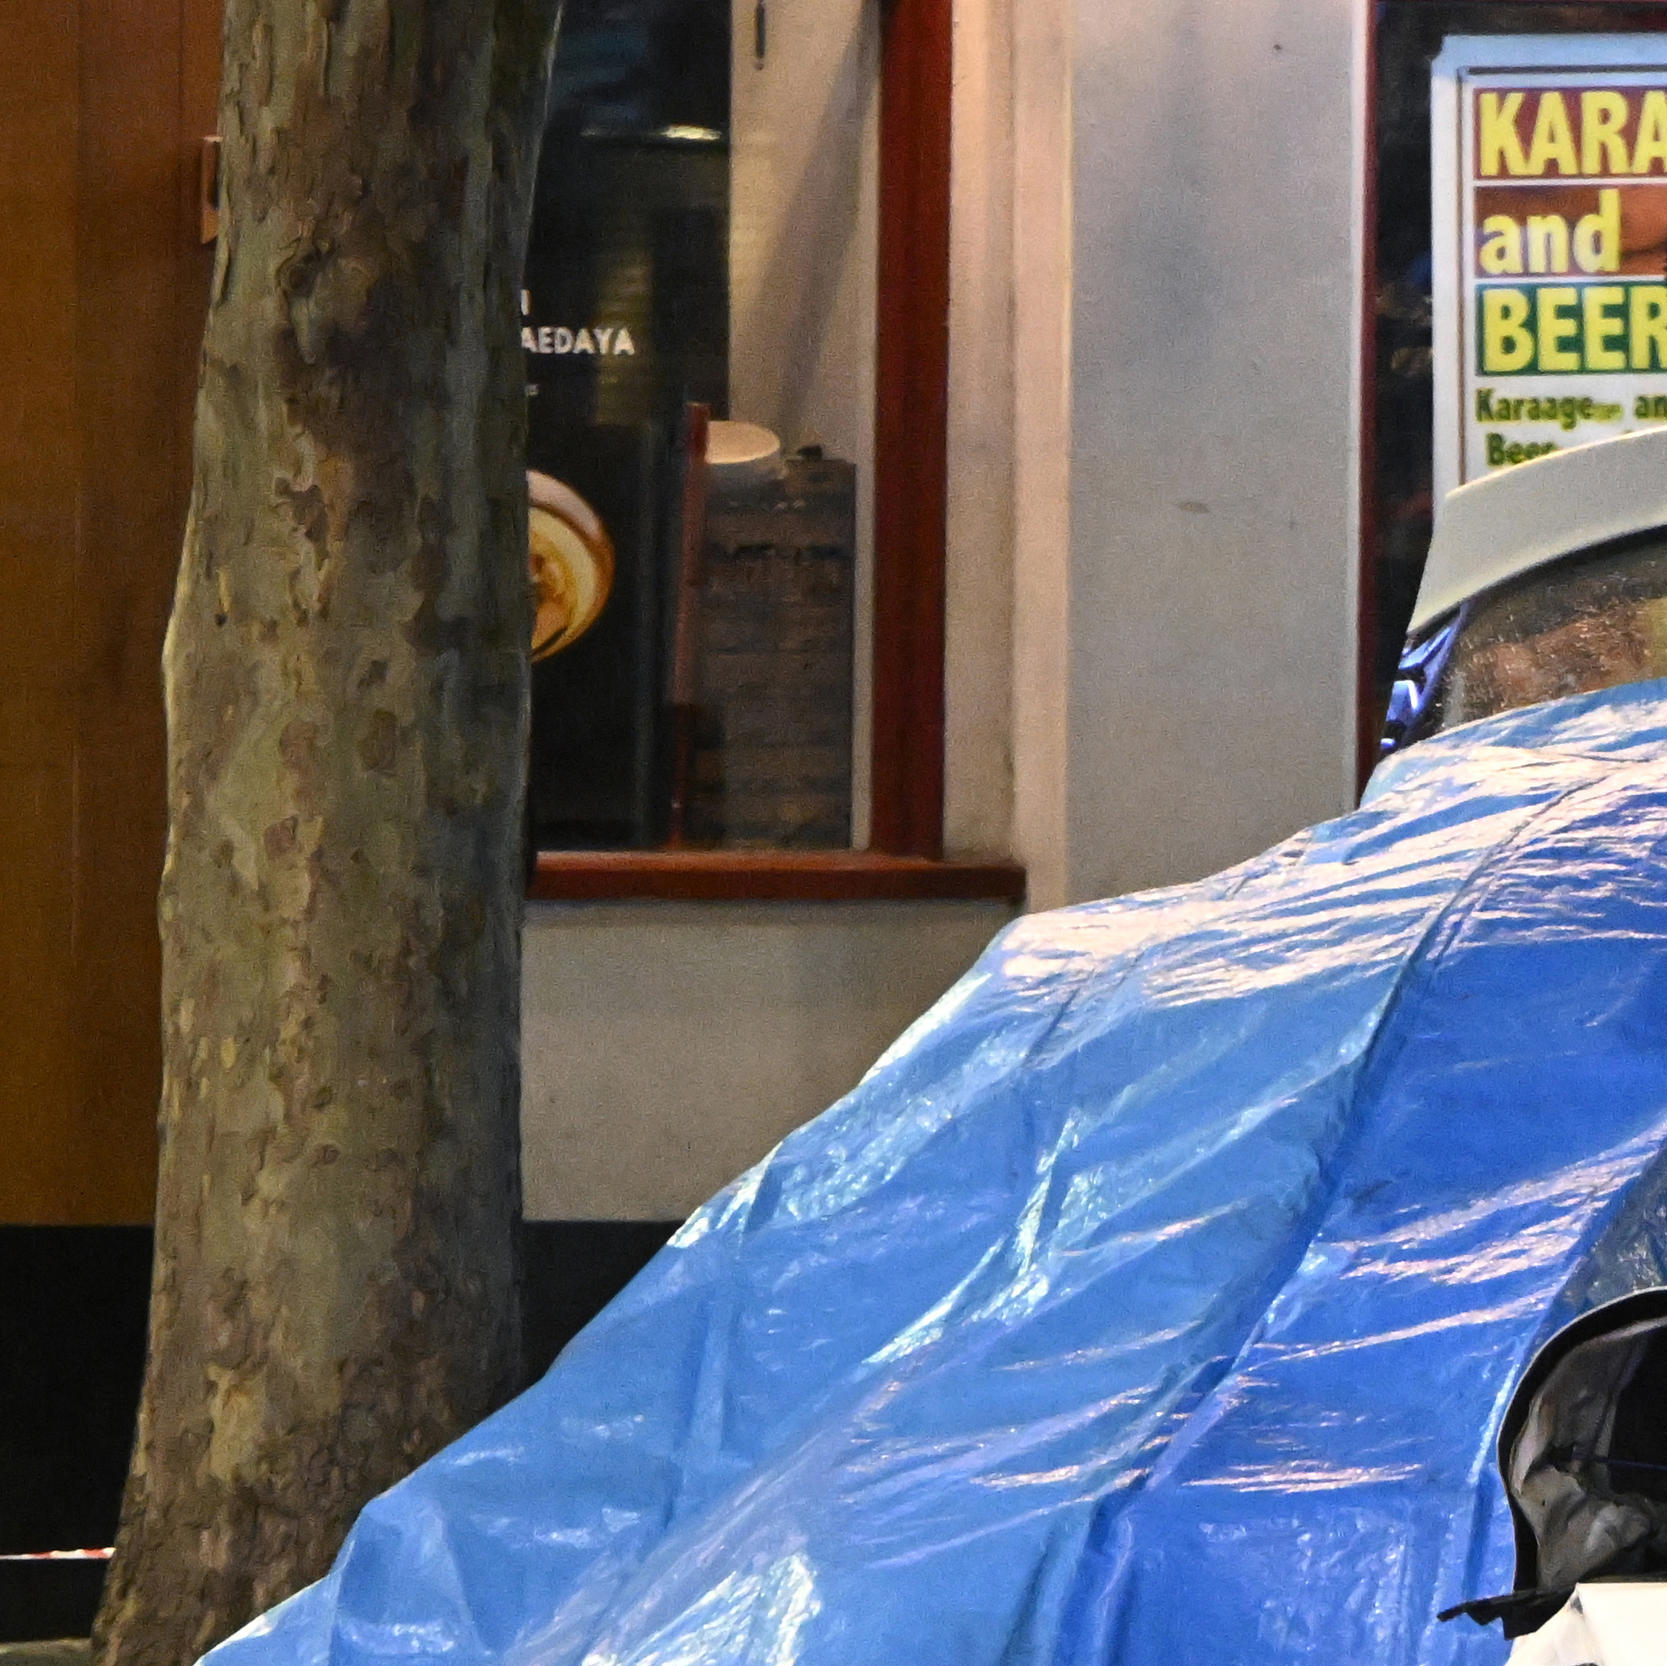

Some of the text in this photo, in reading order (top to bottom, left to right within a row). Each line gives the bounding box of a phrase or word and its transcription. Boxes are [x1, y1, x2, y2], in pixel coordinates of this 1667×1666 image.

[1480, 188, 1621, 276] and
[520, 325, 635, 355] AEDAYA
[1476, 388, 1594, 430] Karaage
